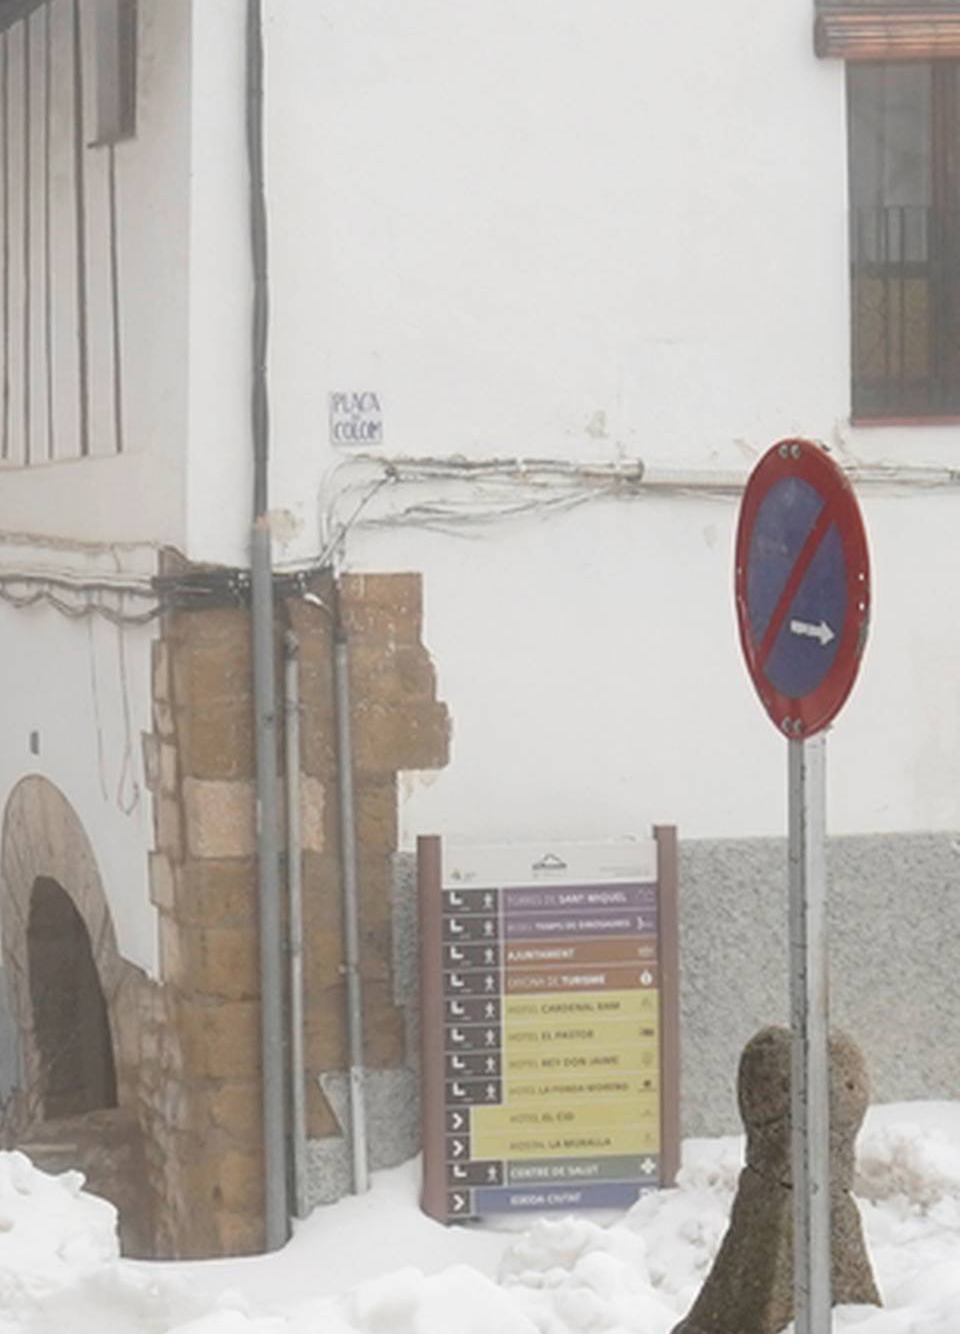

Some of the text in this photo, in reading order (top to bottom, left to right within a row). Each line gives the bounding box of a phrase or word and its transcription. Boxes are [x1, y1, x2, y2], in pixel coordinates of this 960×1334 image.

[558, 893, 584, 904] SANT
[587, 891, 628, 904] MIQUEL
[508, 947, 575, 961] AJUNTAMENT
[561, 974, 606, 985] TURISME
[541, 1002, 594, 1013] CARDENAL
[554, 1029, 594, 1039] PASTOR
[510, 1167, 550, 1179] CENTRE
[552, 1166, 565, 1177] DE
